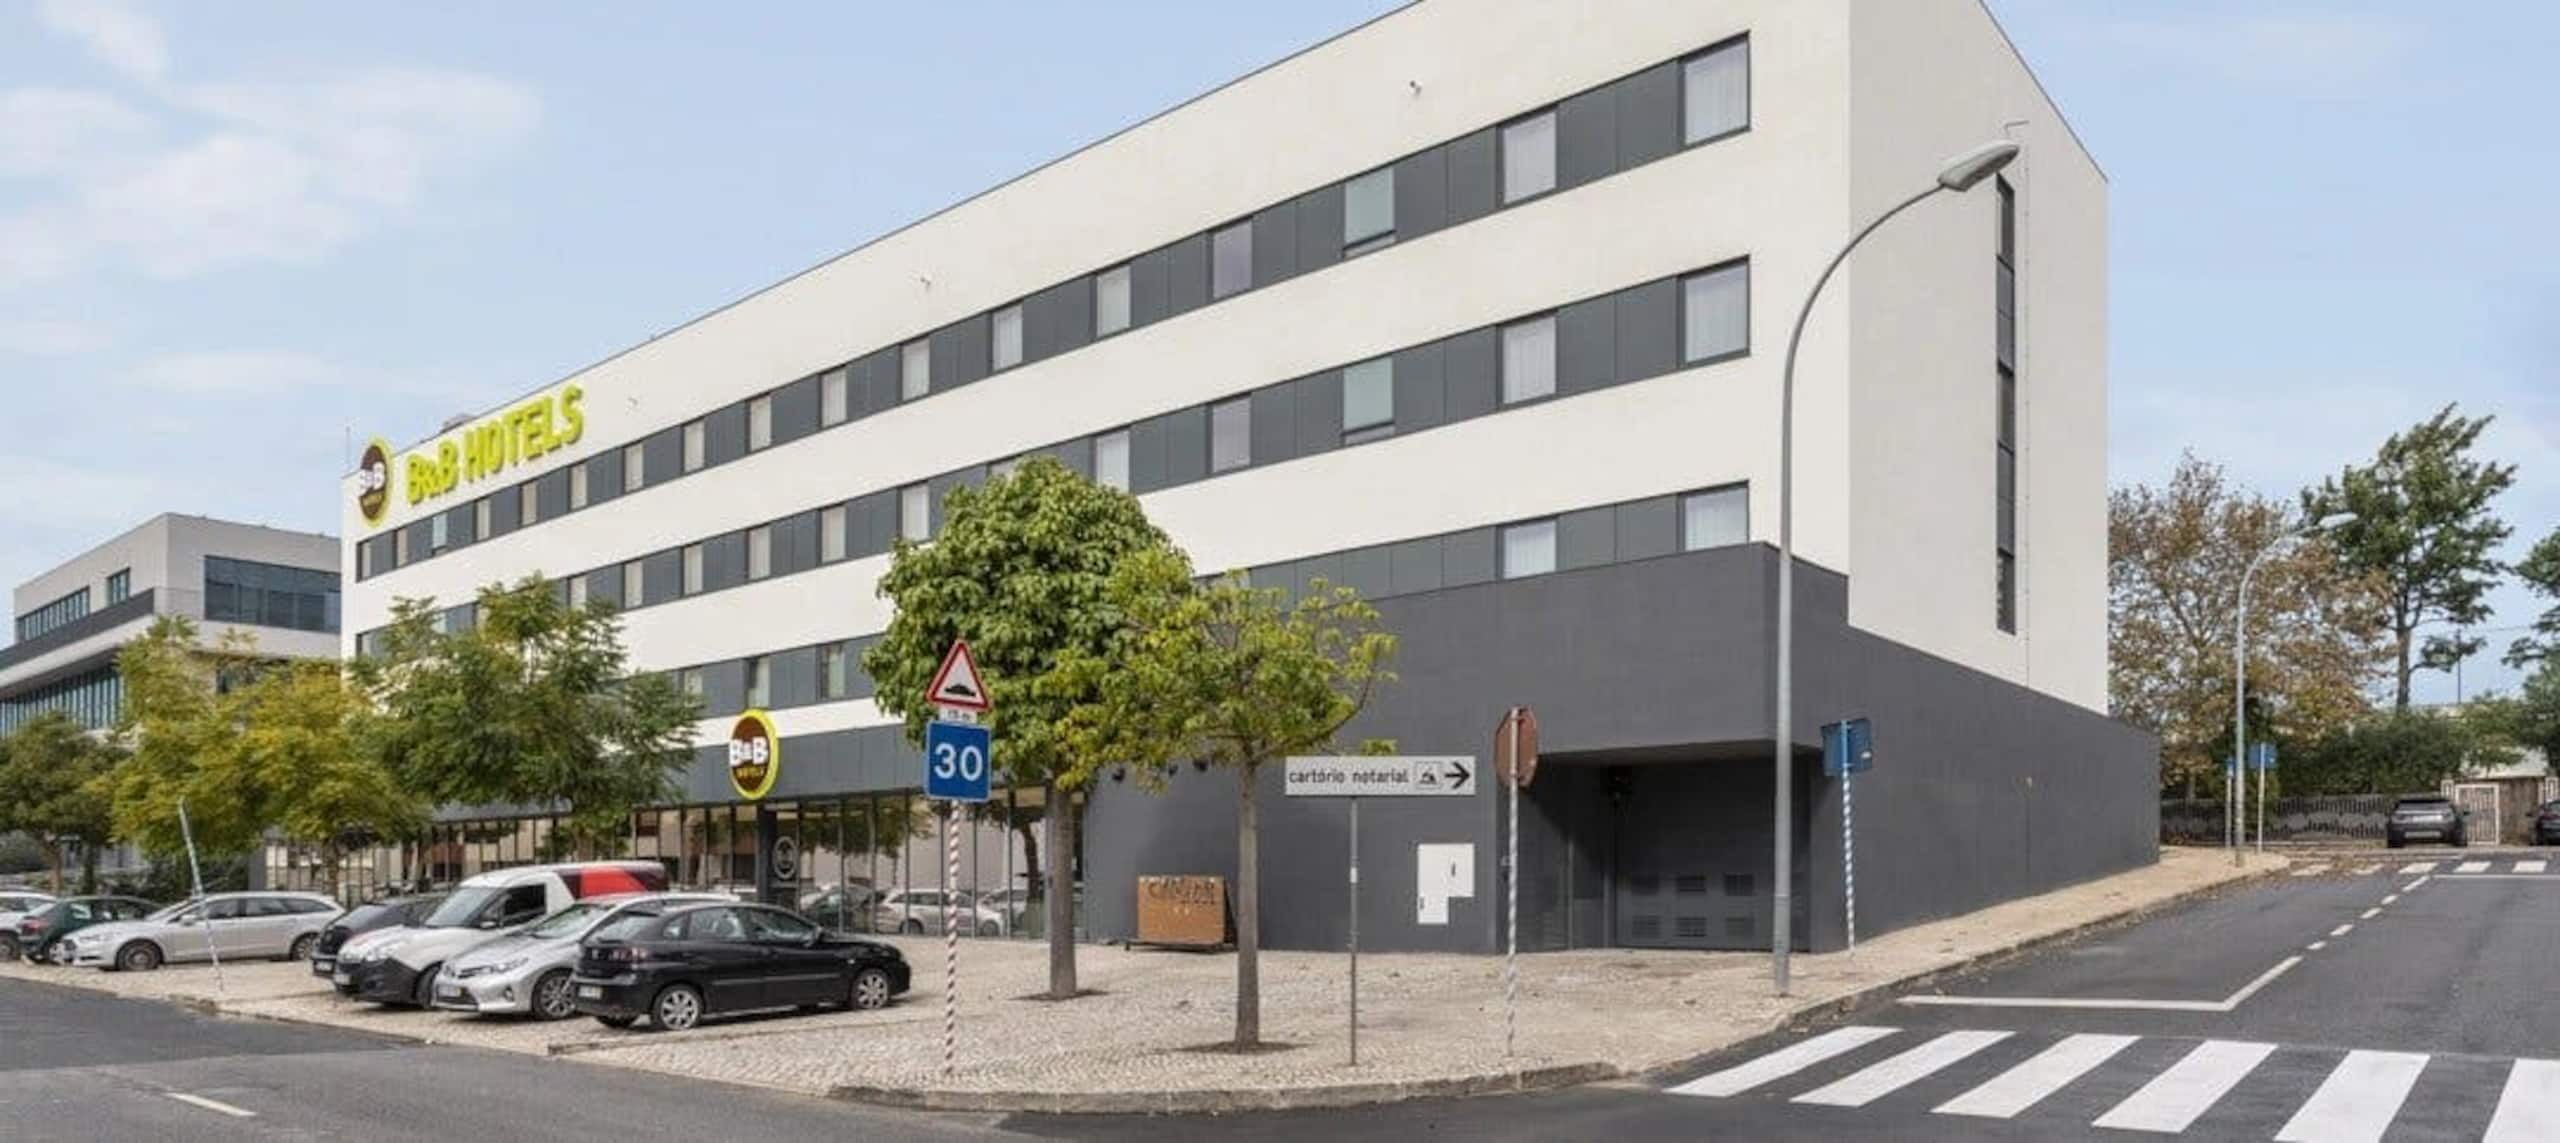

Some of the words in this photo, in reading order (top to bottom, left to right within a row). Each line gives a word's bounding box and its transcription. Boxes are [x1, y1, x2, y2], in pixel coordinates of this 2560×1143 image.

[405, 439, 458, 506] B&B
[463, 384, 583, 483] HOTELS
[933, 743, 983, 781] 30
[1289, 768, 1345, 784] cartório
[1353, 768, 1409, 784] notarial
